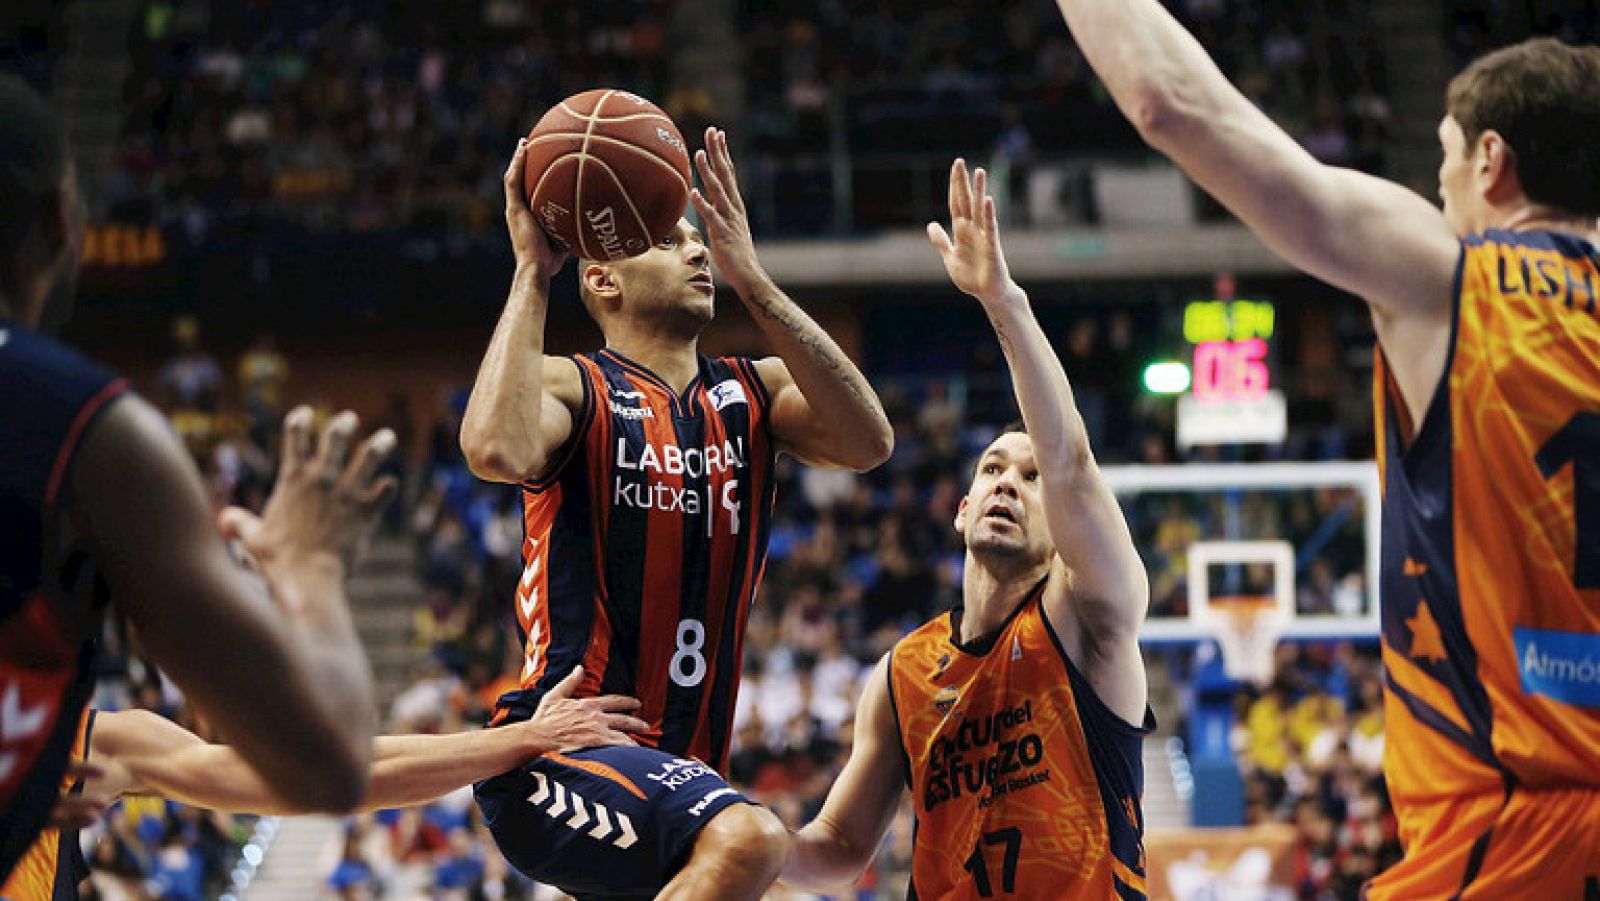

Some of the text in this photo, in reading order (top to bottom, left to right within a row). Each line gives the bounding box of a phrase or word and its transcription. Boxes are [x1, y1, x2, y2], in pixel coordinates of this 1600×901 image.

[1497, 255, 1597, 314] LISH
[614, 475, 701, 514] kutxa
[668, 618, 707, 687] 8
[963, 826, 1022, 898] 17
